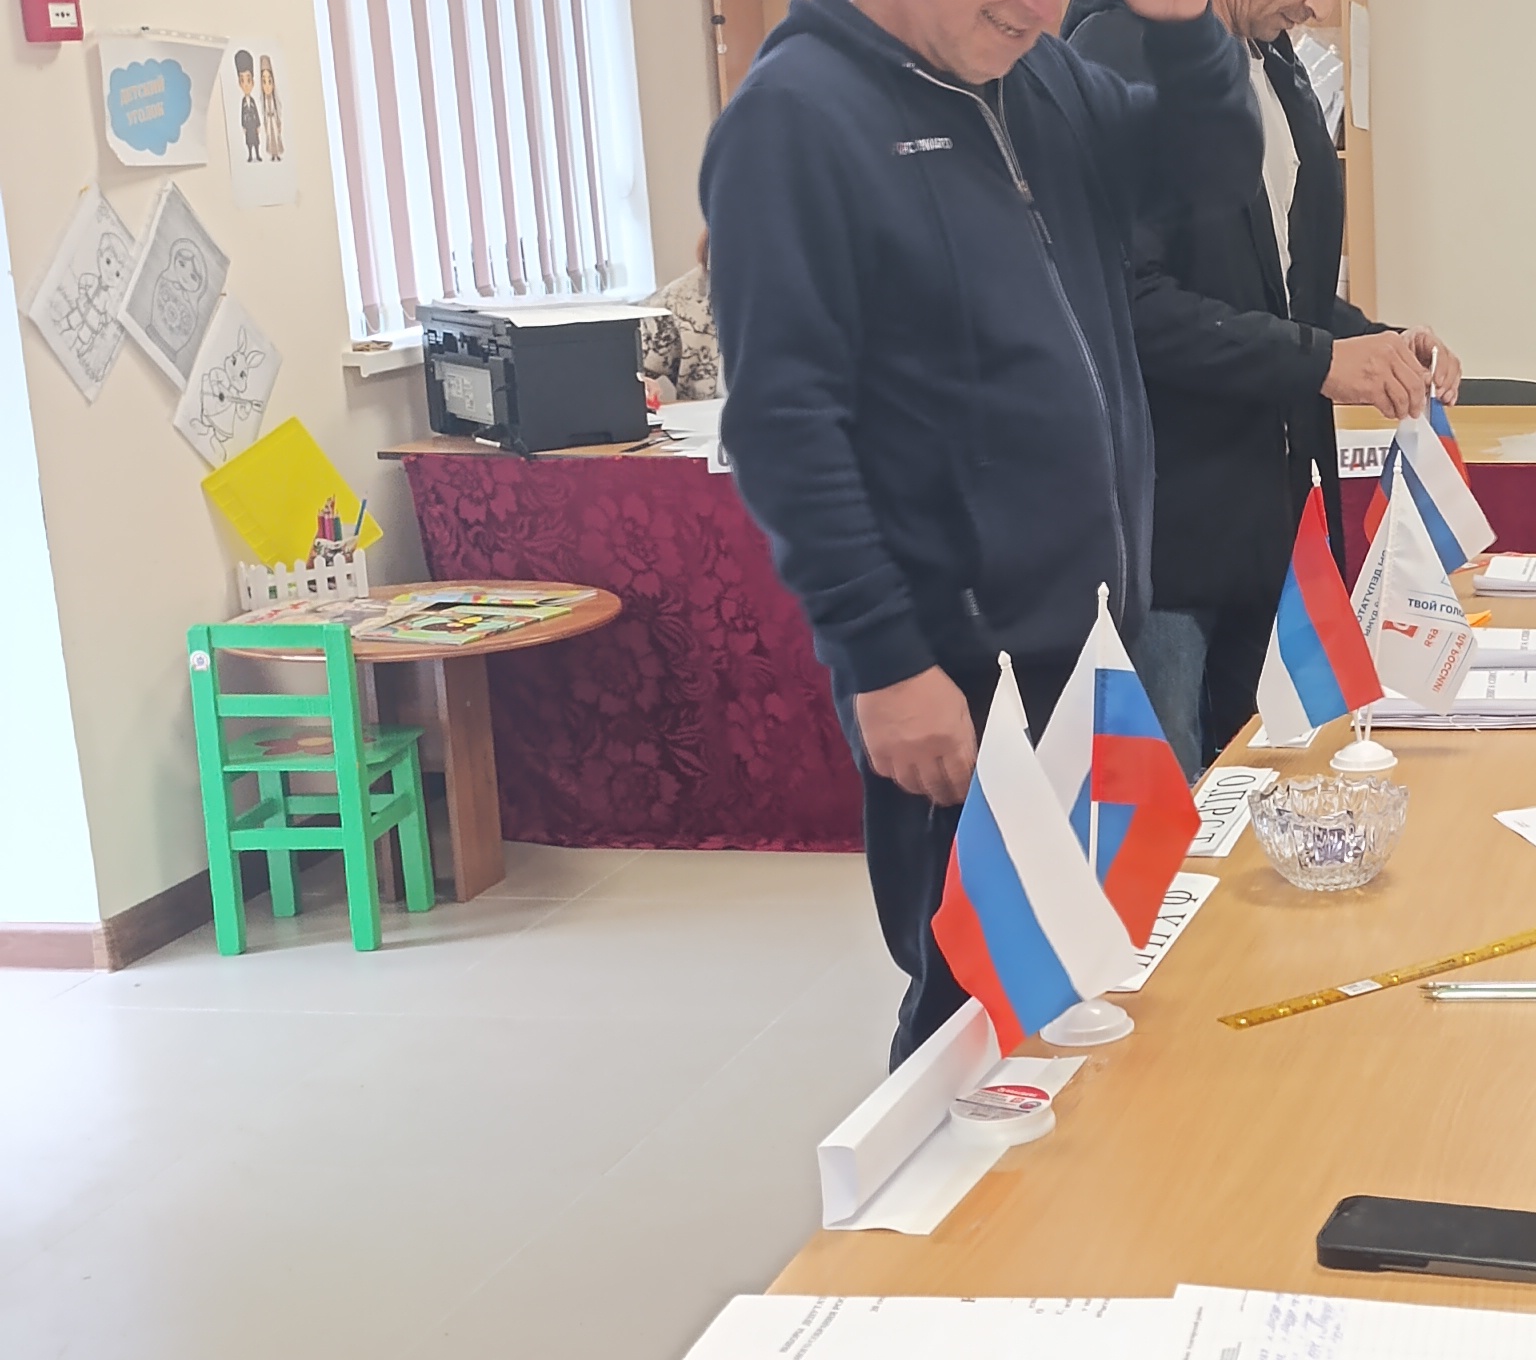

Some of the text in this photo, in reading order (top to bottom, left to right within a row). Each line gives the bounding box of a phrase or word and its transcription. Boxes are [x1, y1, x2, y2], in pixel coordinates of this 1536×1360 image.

[1340, 446, 1391, 471] ЕДАТ
[1407, 597, 1465, 618] ТВОЙ ГОЛ
